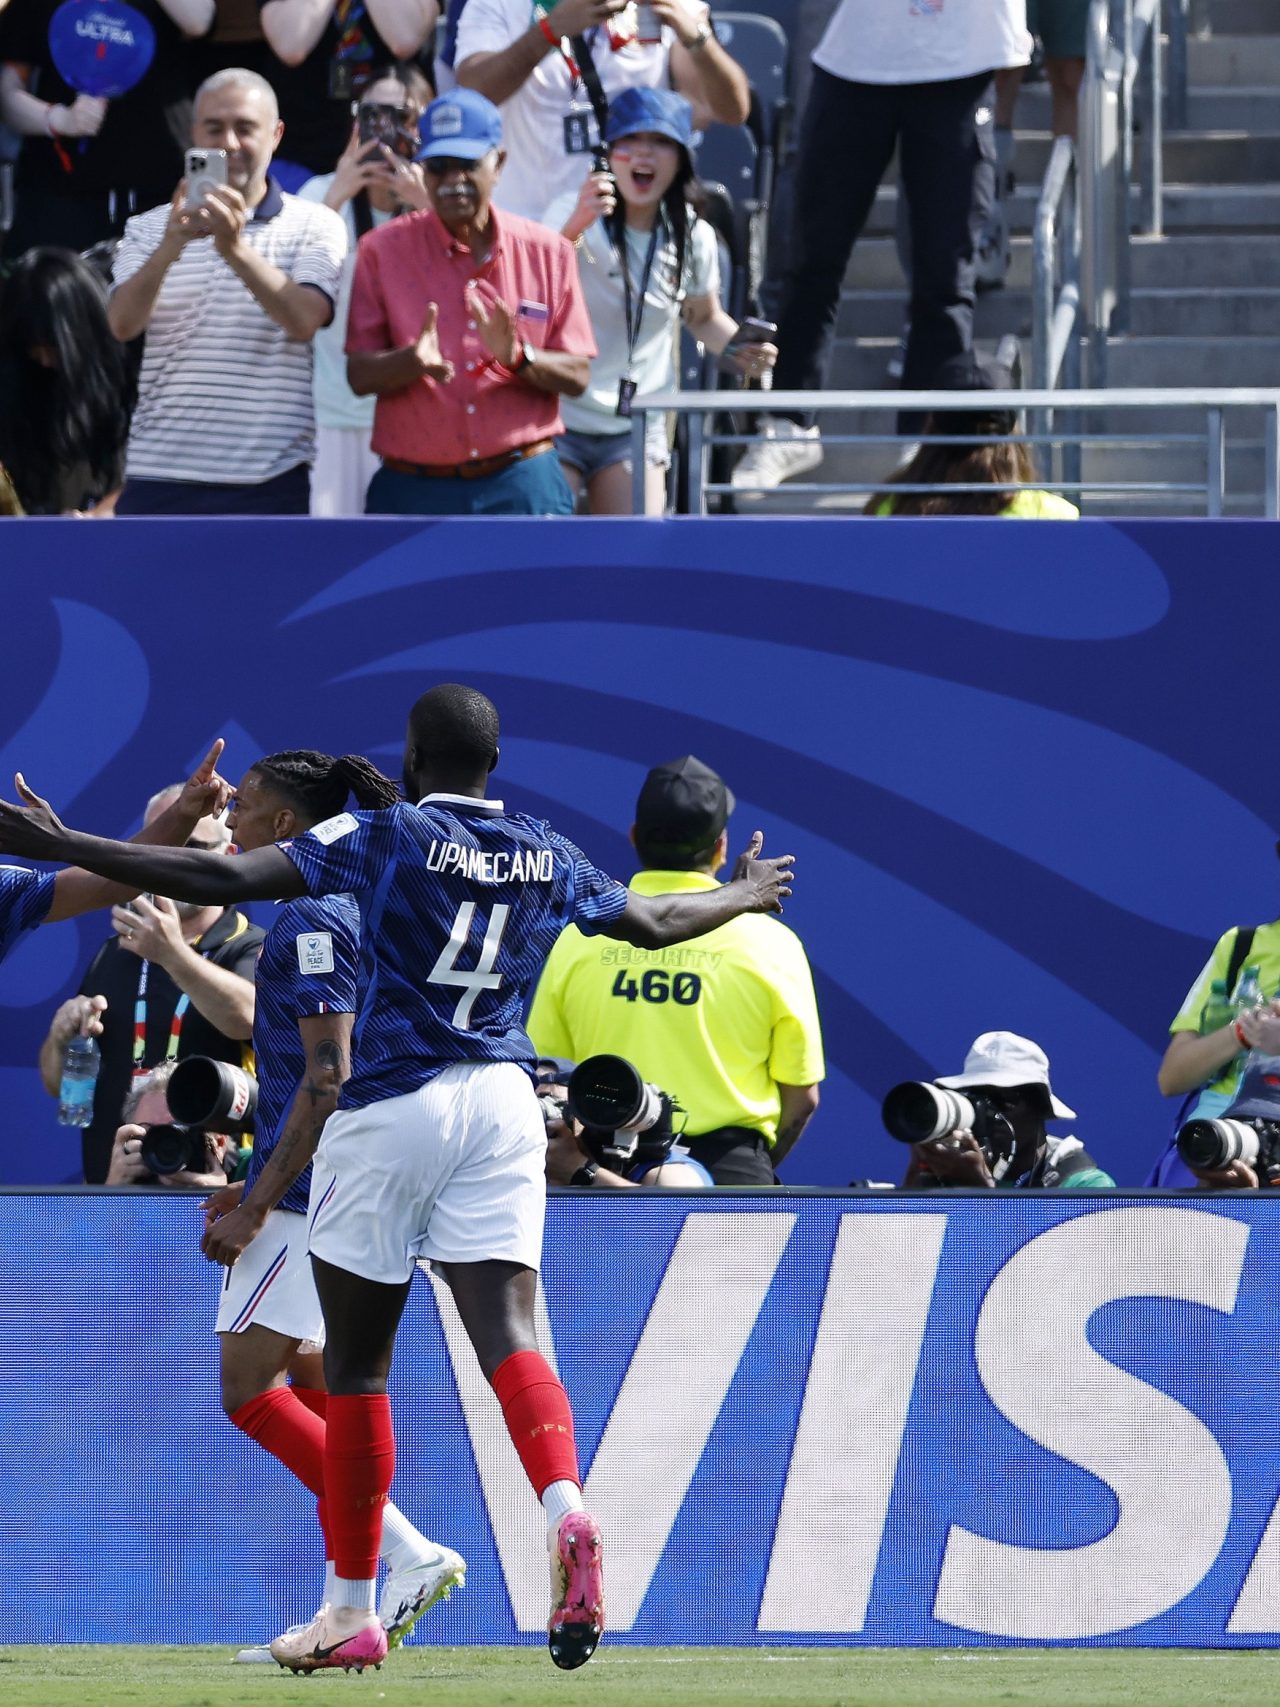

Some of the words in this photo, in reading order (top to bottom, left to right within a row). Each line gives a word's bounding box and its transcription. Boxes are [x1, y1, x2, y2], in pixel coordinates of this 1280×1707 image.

[426, 840, 553, 883] UPAMECANO
[426, 901, 511, 1030] 4
[600, 946, 723, 970] SECURITY
[612, 969, 702, 1006] 460
[415, 1206, 1280, 1640] VIS
